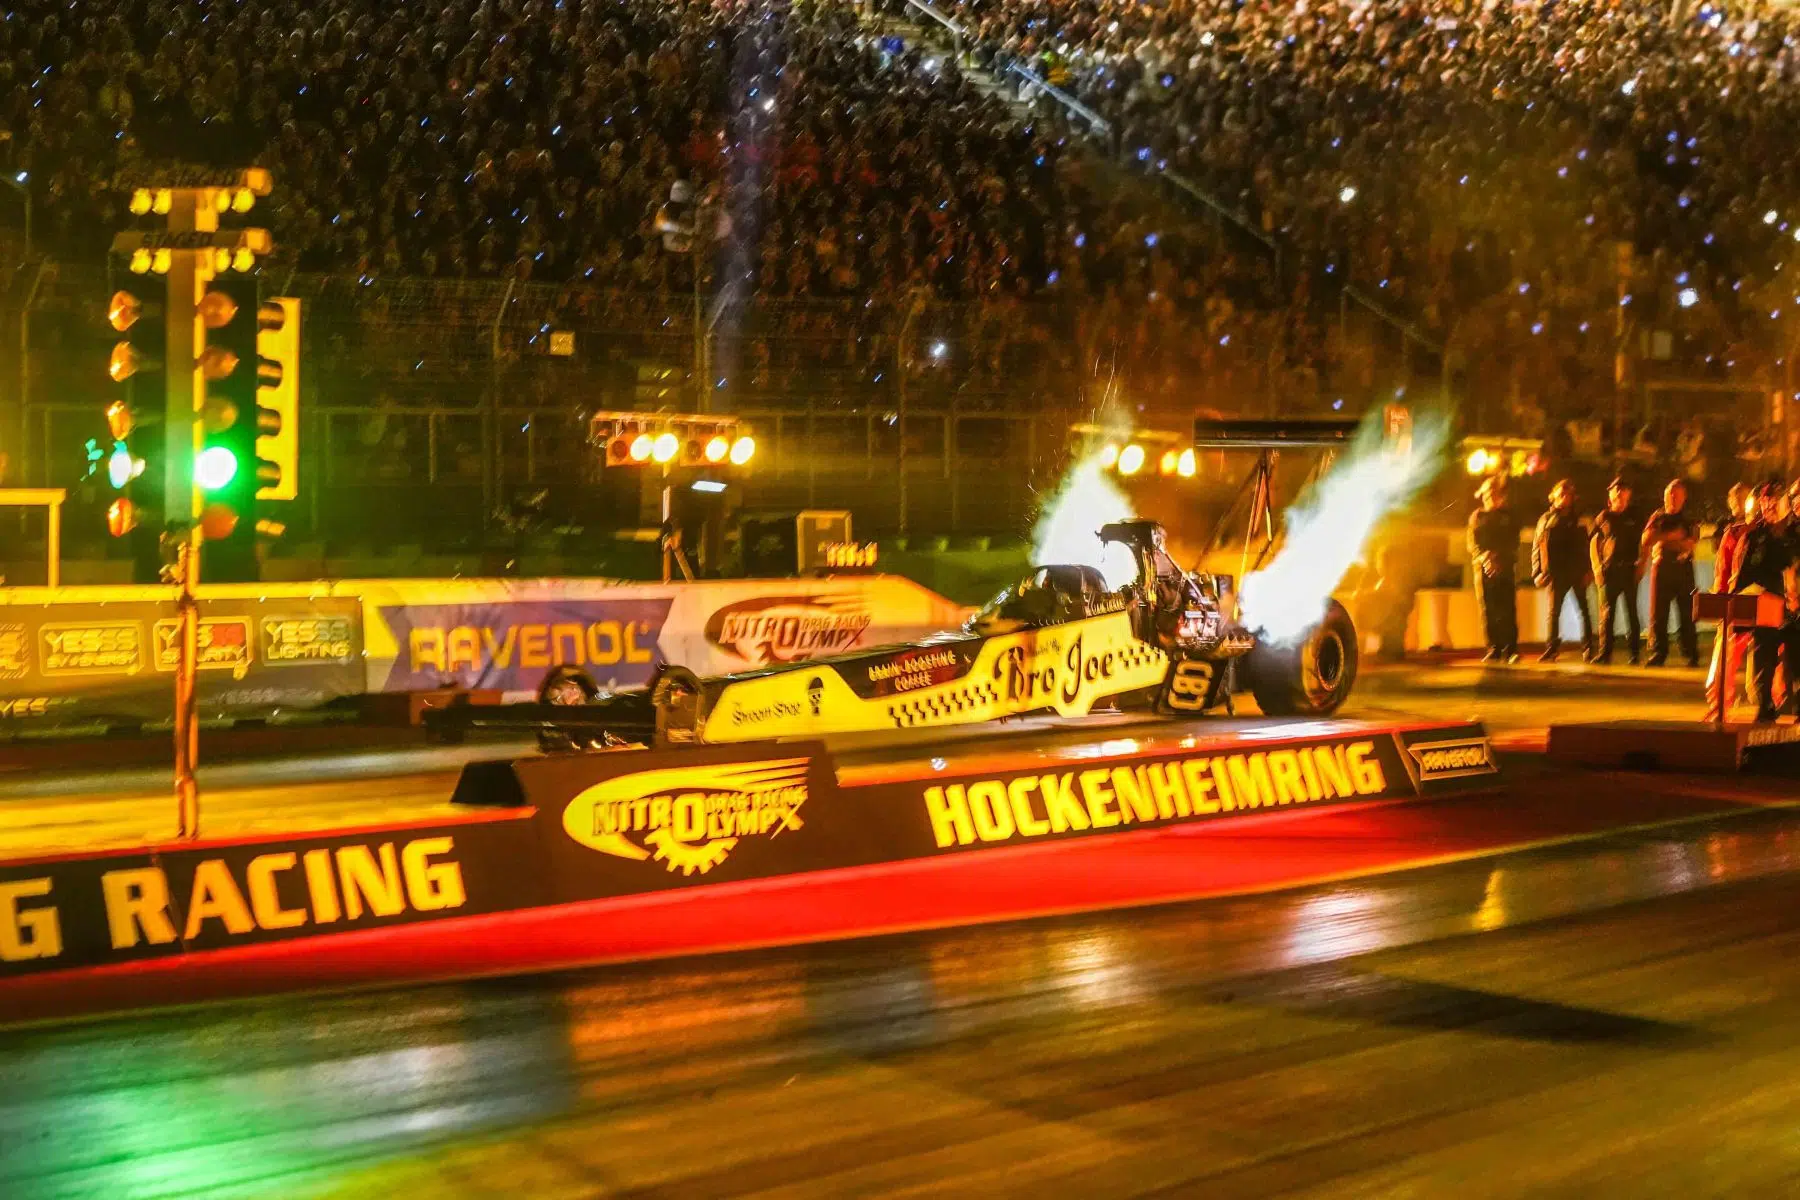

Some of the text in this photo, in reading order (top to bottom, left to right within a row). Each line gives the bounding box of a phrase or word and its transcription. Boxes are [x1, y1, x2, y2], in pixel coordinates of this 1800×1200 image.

[268, 640, 350, 659] LIGHTING
[409, 620, 653, 672] RAVENOL
[994, 630, 1114, 705] Bro Joe
[923, 740, 1387, 849] HOCKENHEIMRING
[101, 836, 467, 950] RACING
